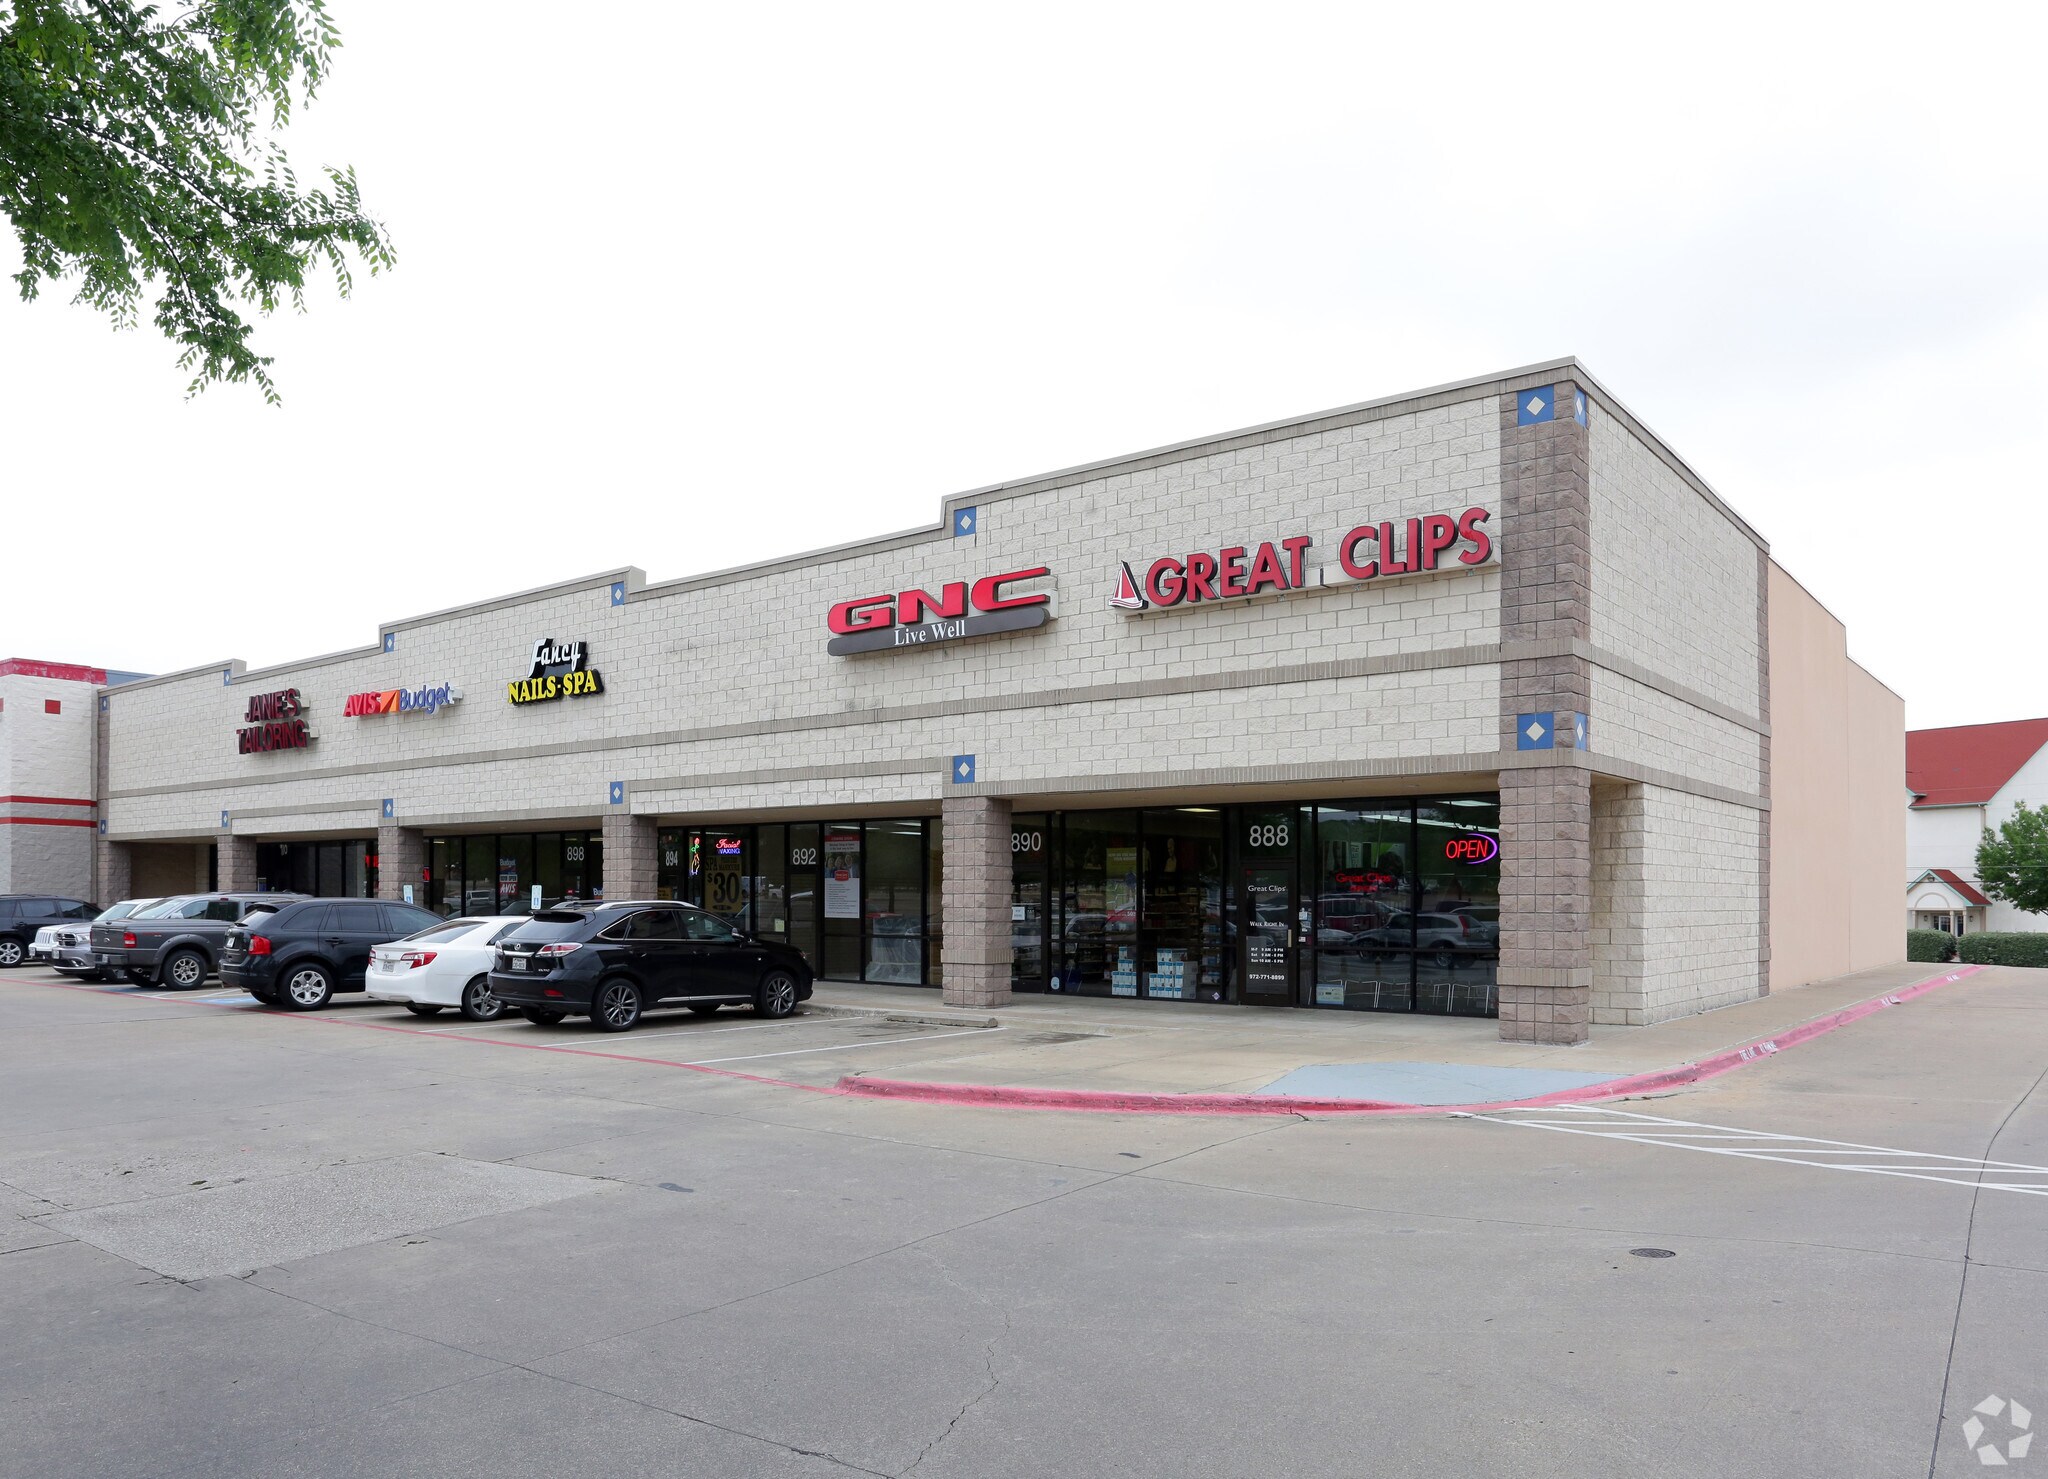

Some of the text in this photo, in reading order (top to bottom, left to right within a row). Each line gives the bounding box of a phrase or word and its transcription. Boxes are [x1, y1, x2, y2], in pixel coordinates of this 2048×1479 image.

[1145, 506, 1494, 607] GREAT CLIPS
[827, 566, 1051, 635] GNC
[894, 619, 966, 646] Live Well
[528, 637, 582, 678] Fancy
[343, 681, 451, 717] AVIS Budget
[507, 669, 598, 704] NAILS SPA
[245, 687, 301, 723] JANIE'S
[236, 719, 310, 755] TAILORING
[1011, 832, 1041, 852] 890
[1249, 824, 1289, 847] 888
[1445, 839, 1489, 859] OPEN
[567, 846, 585, 861] 898
[665, 850, 679, 867] 894
[792, 848, 817, 866] 892
[707, 872, 741, 904] $30
